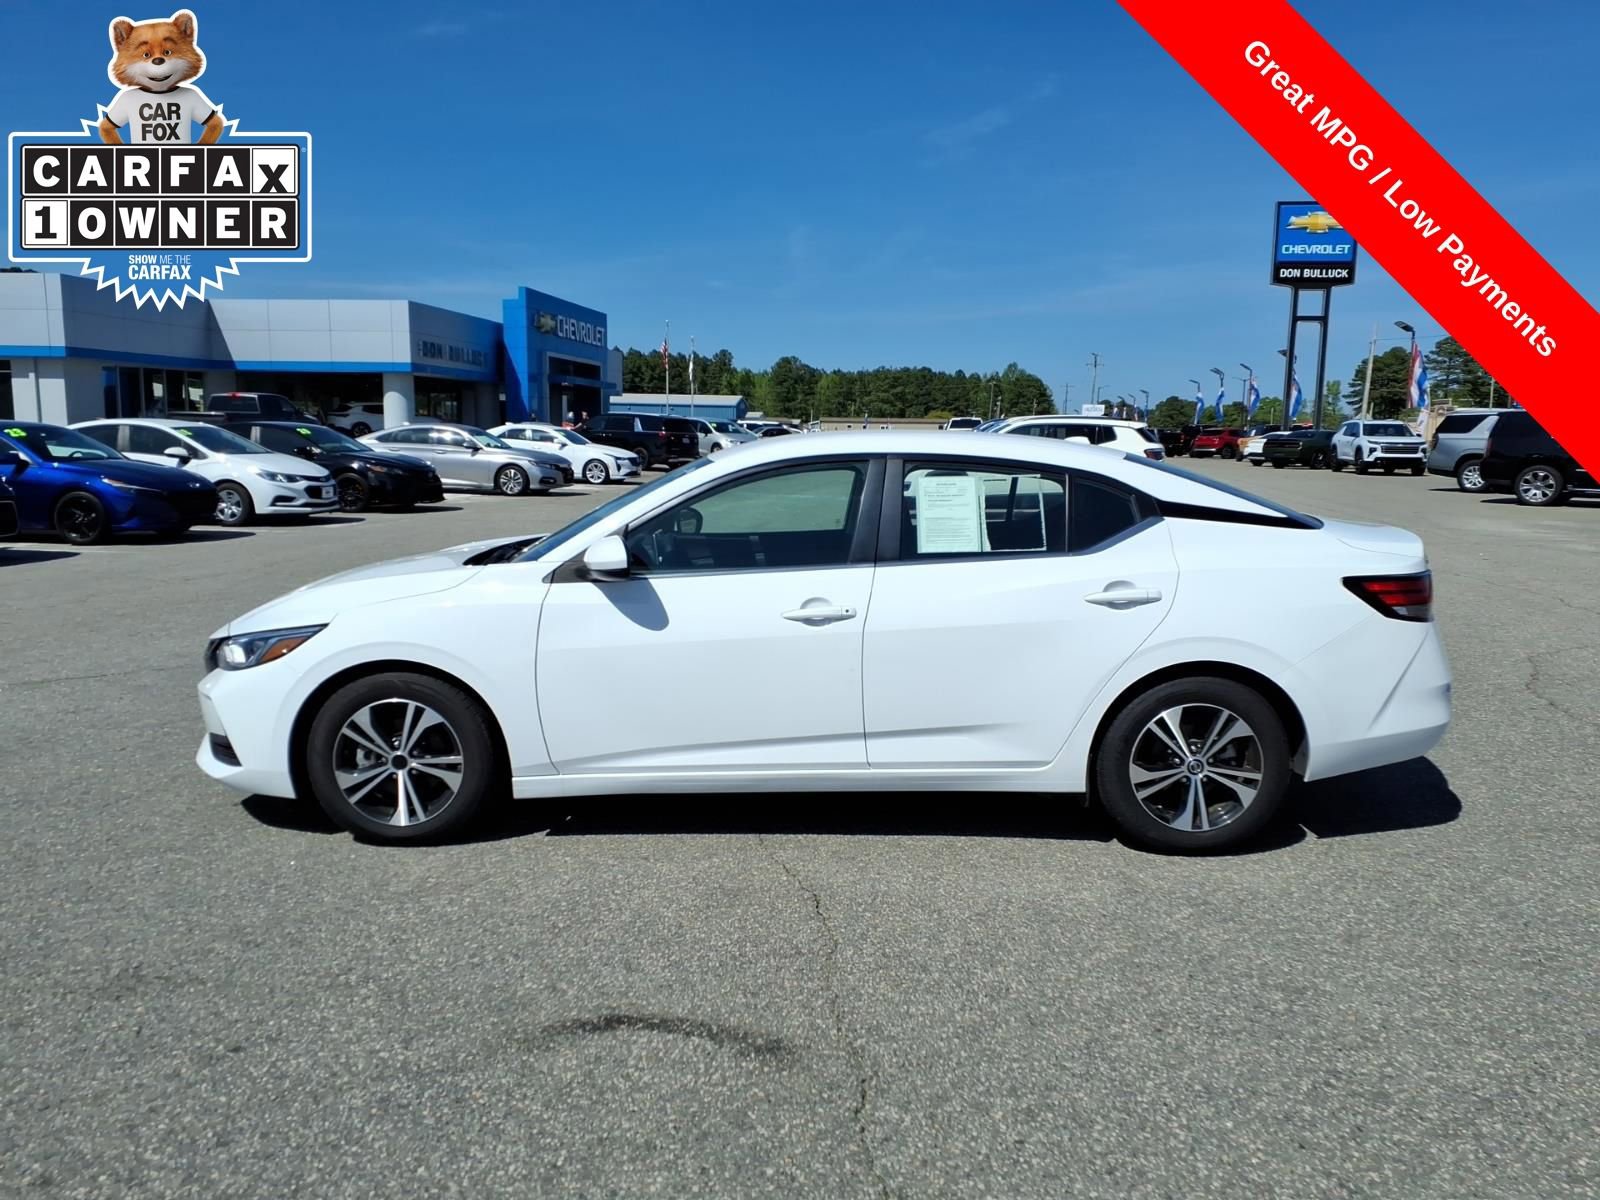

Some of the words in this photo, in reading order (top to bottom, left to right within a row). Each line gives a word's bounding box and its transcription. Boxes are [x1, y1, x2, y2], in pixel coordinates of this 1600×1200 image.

[1281, 244, 1351, 254] CHEVROLET
[1280, 268, 1301, 278] DON
[1303, 268, 1349, 278] BULLUCK
[557, 315, 605, 346] CHEVROLET
